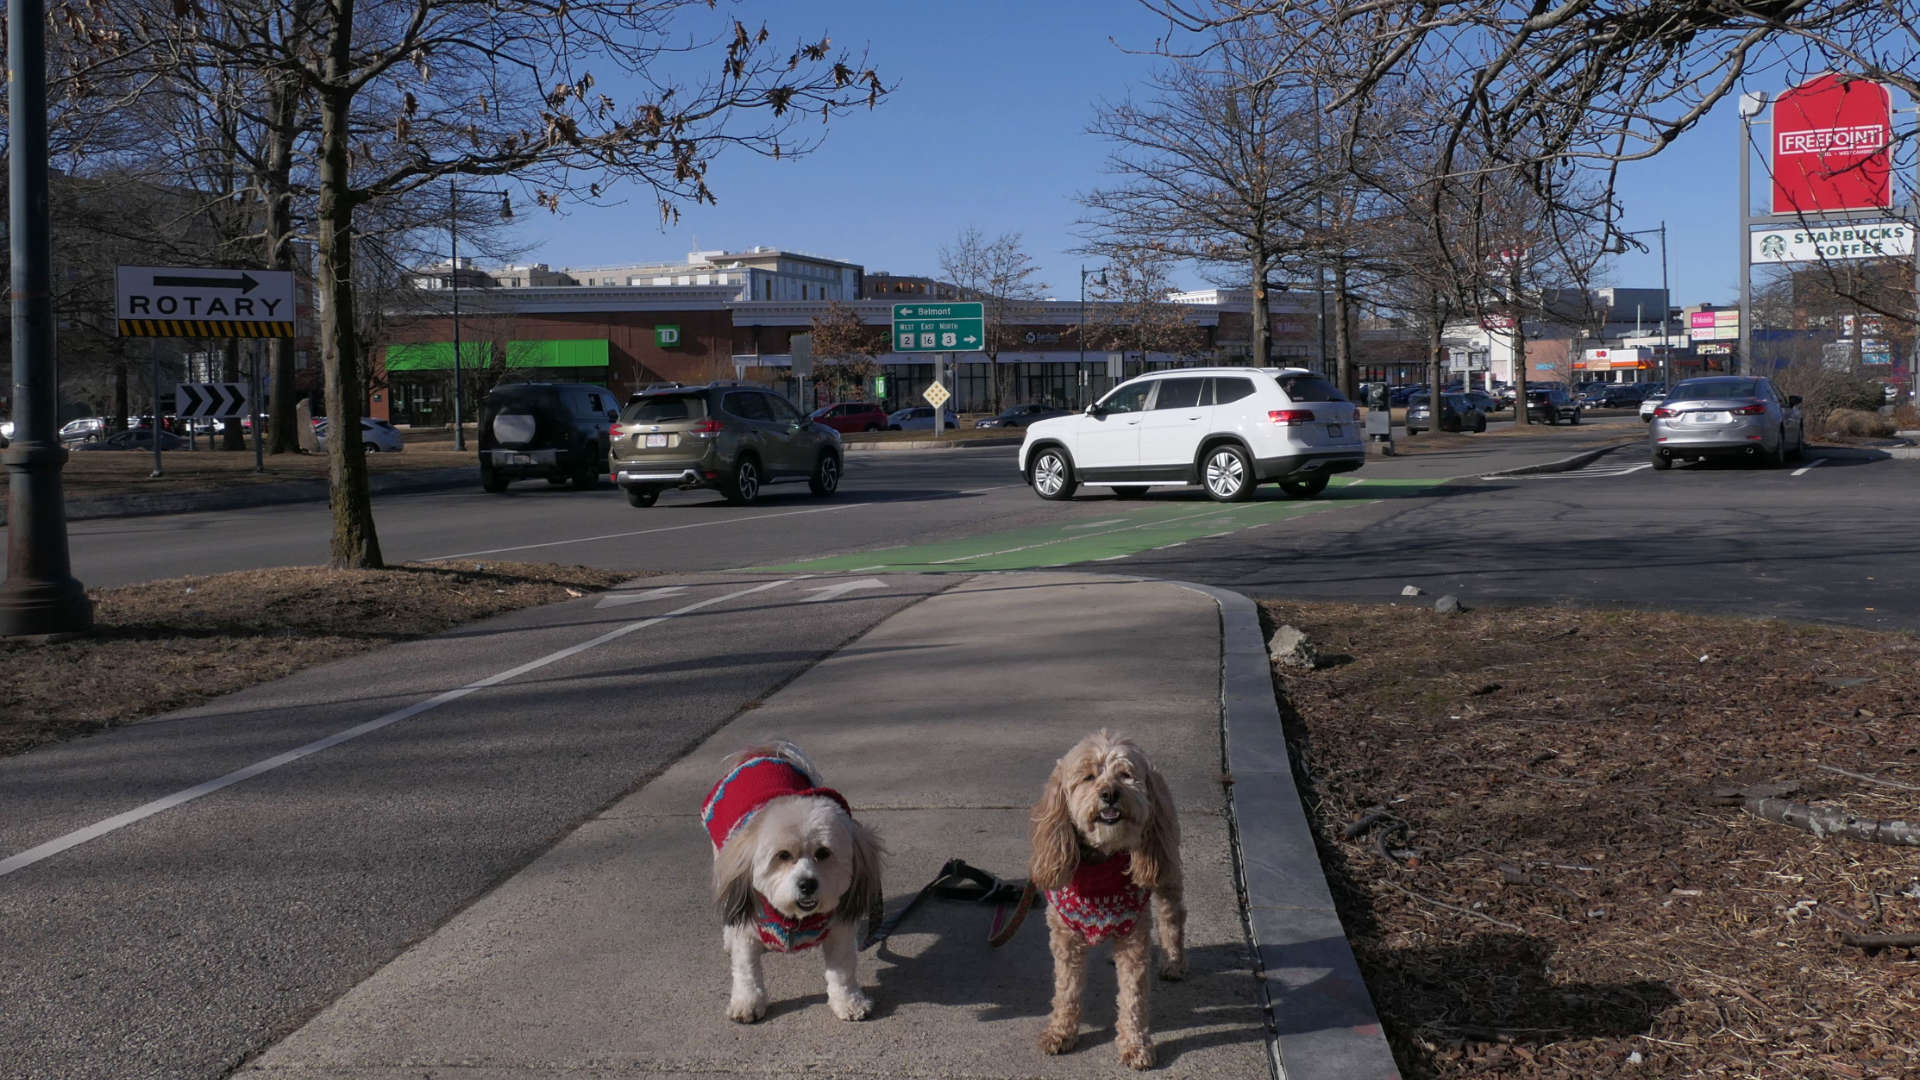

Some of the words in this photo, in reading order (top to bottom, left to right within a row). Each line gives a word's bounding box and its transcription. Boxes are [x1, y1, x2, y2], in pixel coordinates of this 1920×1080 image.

[1794, 227, 1905, 244] STARBUCKS
[1815, 243, 1883, 257] COFFEE
[129, 295, 282, 317] ROTARY
[918, 308, 951, 316] Belmont
[657, 328, 678, 343] TD
[924, 336, 933, 345] 16
